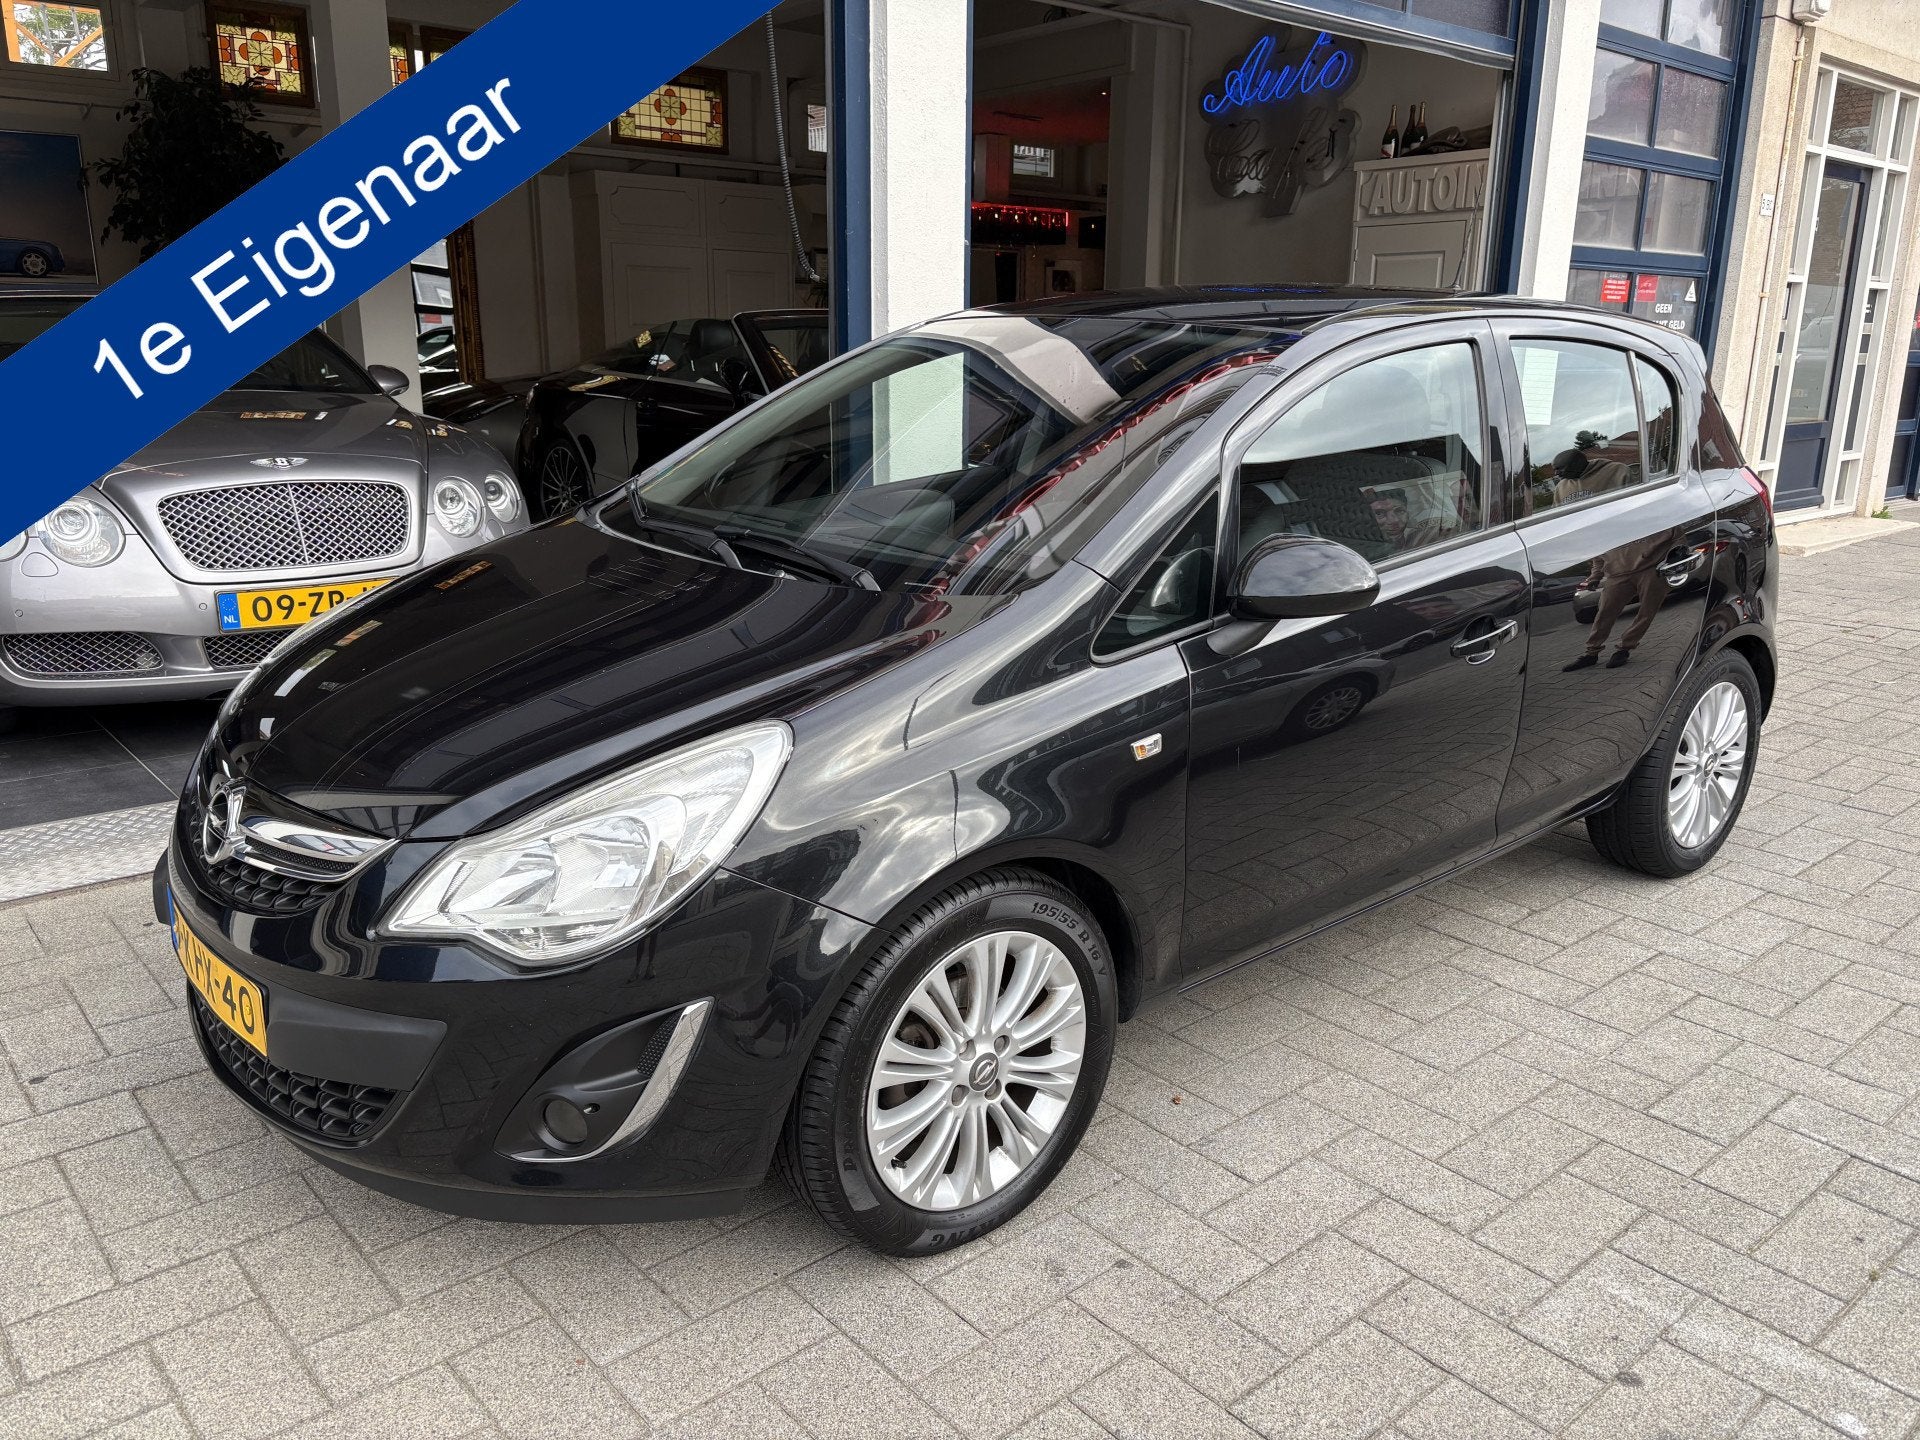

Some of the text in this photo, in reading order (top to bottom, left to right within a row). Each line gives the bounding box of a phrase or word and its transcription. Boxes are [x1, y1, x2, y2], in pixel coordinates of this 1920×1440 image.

[1203, 32, 1347, 112] Auto
[1655, 303, 1672, 314] GEEN
[1668, 320, 1685, 330] GELD
[223, 615, 238, 624] NL
[1078, 929, 1090, 944] R
